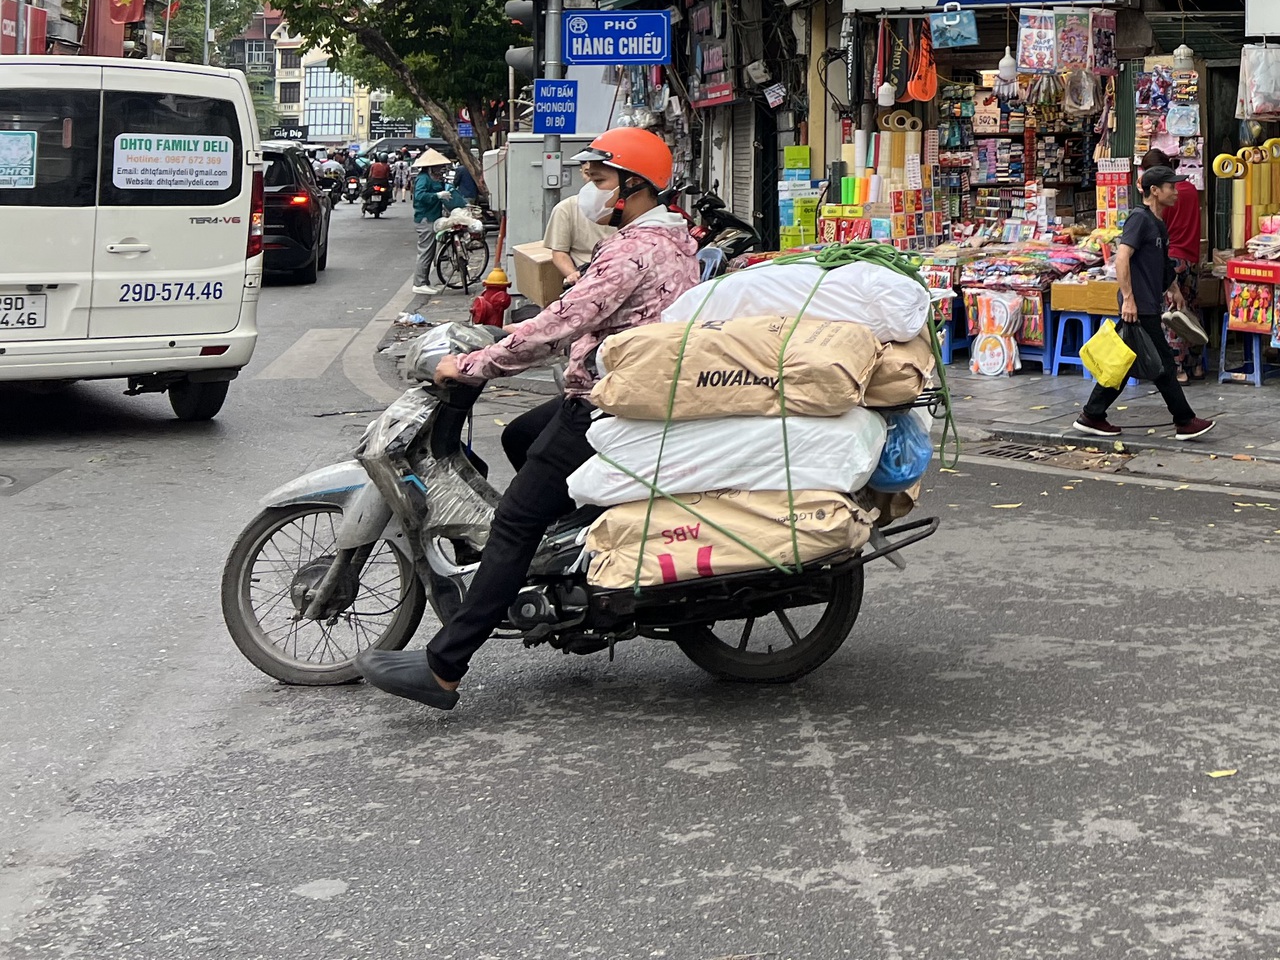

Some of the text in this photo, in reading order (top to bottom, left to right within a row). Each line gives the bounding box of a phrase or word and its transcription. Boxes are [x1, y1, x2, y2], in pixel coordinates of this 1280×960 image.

[604, 16, 639, 30] PHỐ
[572, 31, 662, 56] HÀNG CHIẾU
[540, 83, 574, 98] NÚT BẤM
[536, 101, 575, 113] CHO NGƯỜI
[545, 116, 566, 129] ĐI BỘ
[119, 138, 229, 153] DHTQ FAMILY DELI
[117, 167, 139, 175] Email:
[188, 216, 242, 225] TERA-V6
[119, 281, 224, 303] 29D-574.46
[0, 296, 25, 311] 9D
[661, 522, 701, 545] ABS
